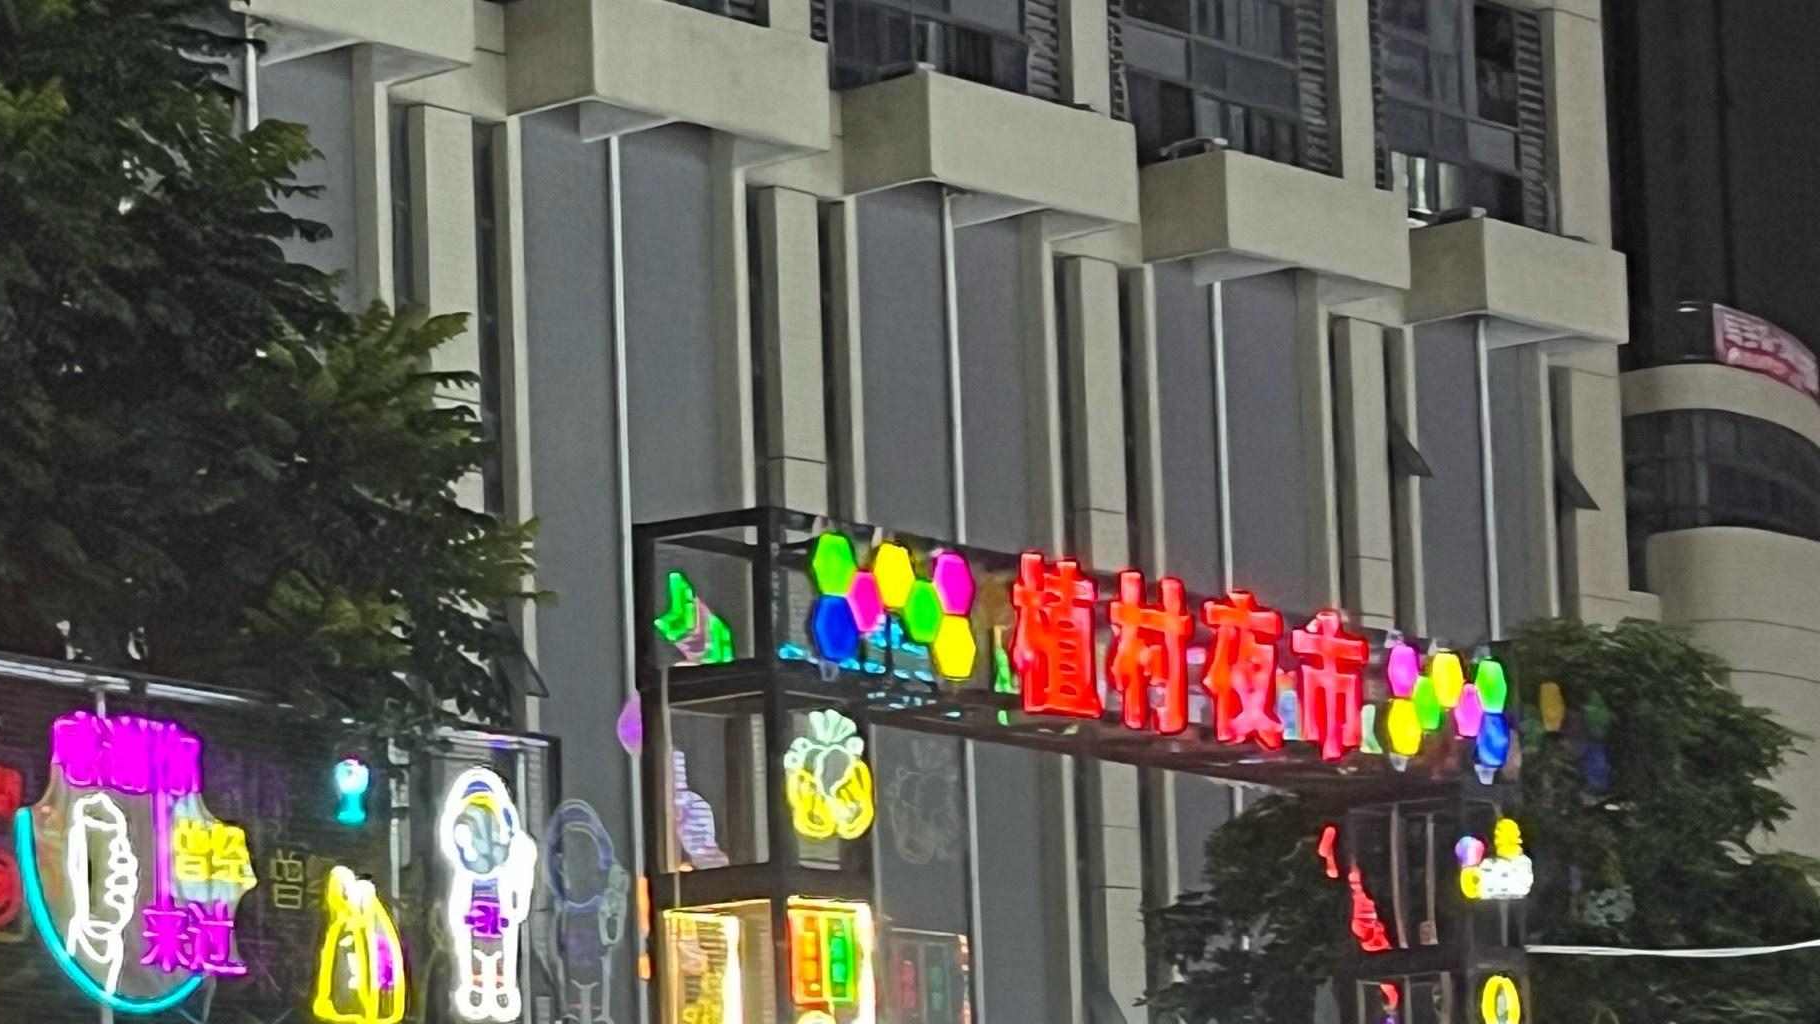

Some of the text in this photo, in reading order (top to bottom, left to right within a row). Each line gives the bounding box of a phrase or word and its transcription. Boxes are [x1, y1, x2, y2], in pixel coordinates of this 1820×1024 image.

[1010, 550, 1369, 762] 植村夜市
[140, 903, 247, 975] 来过
